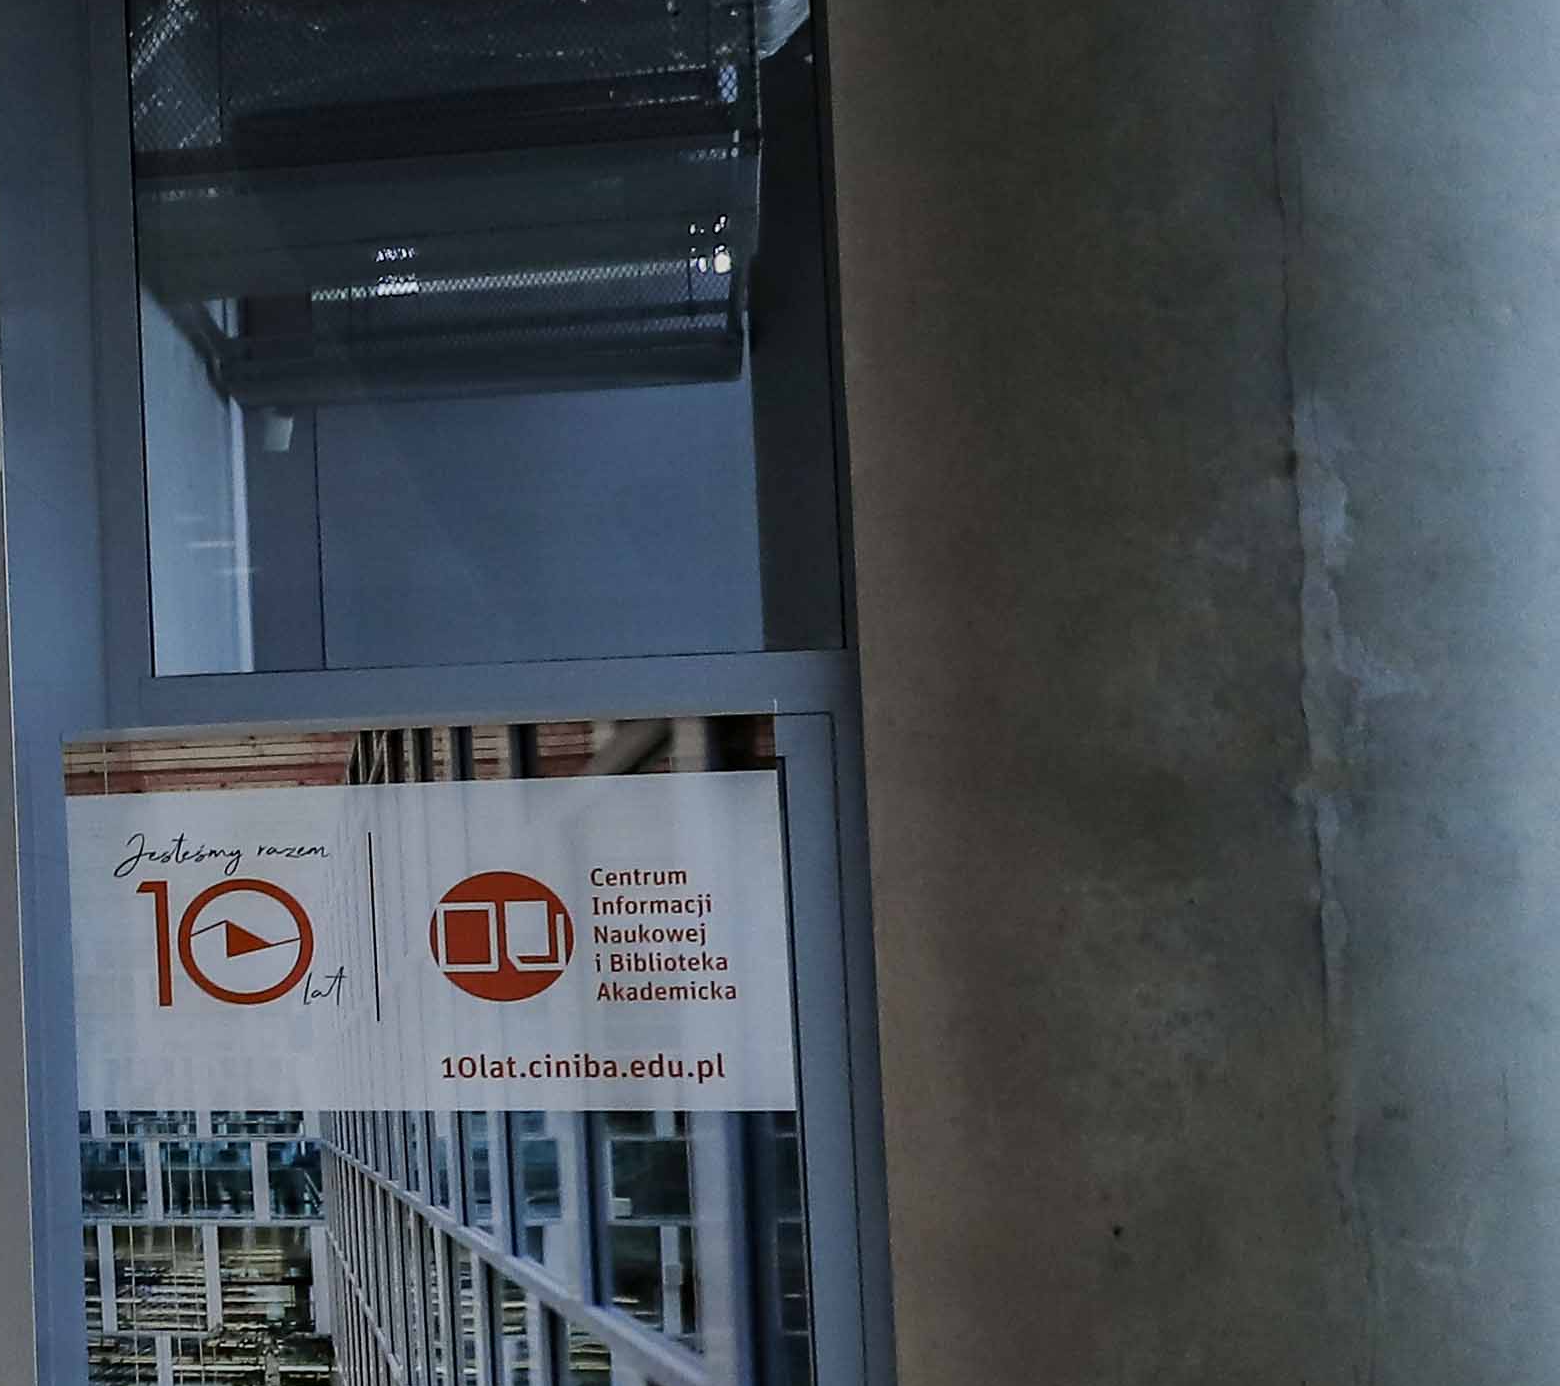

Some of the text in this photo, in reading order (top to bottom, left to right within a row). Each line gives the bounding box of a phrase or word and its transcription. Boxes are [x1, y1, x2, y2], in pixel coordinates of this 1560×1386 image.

[113, 832, 329, 877] Jesteśmy razem
[590, 867, 687, 887] Centrum
[592, 894, 712, 918] Informacji
[593, 922, 706, 946] Naukowej
[596, 953, 728, 973] i Biblioteka
[303, 966, 347, 1006] lat
[596, 981, 737, 1002] Akademicka
[441, 1053, 726, 1084] 10lat.ciniba.edu.pl
